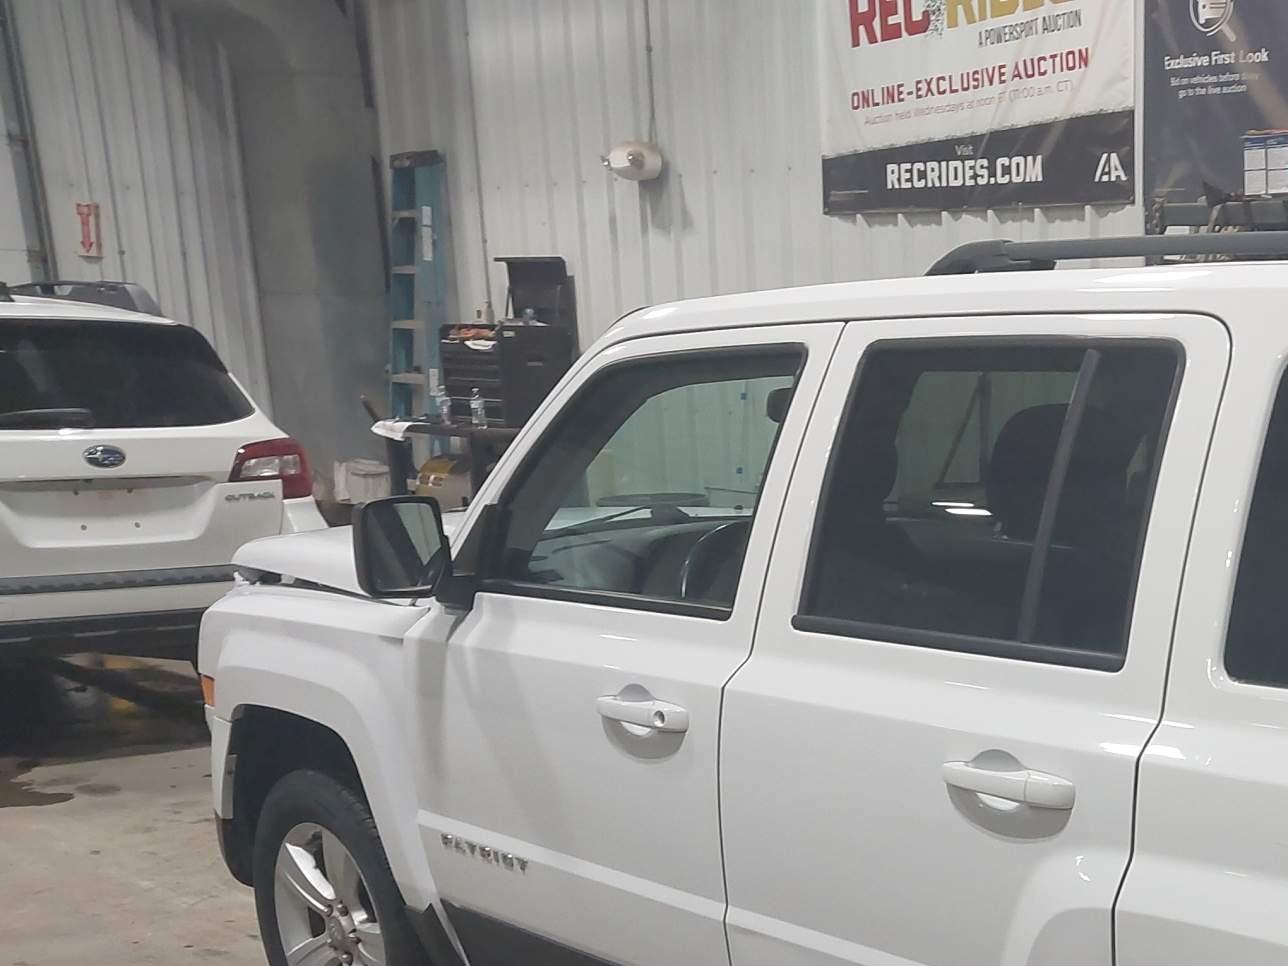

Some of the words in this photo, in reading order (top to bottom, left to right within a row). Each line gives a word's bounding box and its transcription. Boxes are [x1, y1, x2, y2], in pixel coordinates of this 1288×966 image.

[985, 18, 1039, 46] POWERSPORT
[1042, 9, 1082, 34] AUCTION
[1164, 52, 1210, 70] Exclusive
[1210, 50, 1236, 65] First
[1238, 47, 1270, 63] Look
[851, 64, 1007, 111] ONLINE-EXCLUSIVE
[1011, 48, 1089, 82] AUCTION
[955, 144, 974, 155] Visit
[886, 155, 1044, 190] RECRIDES.COM
